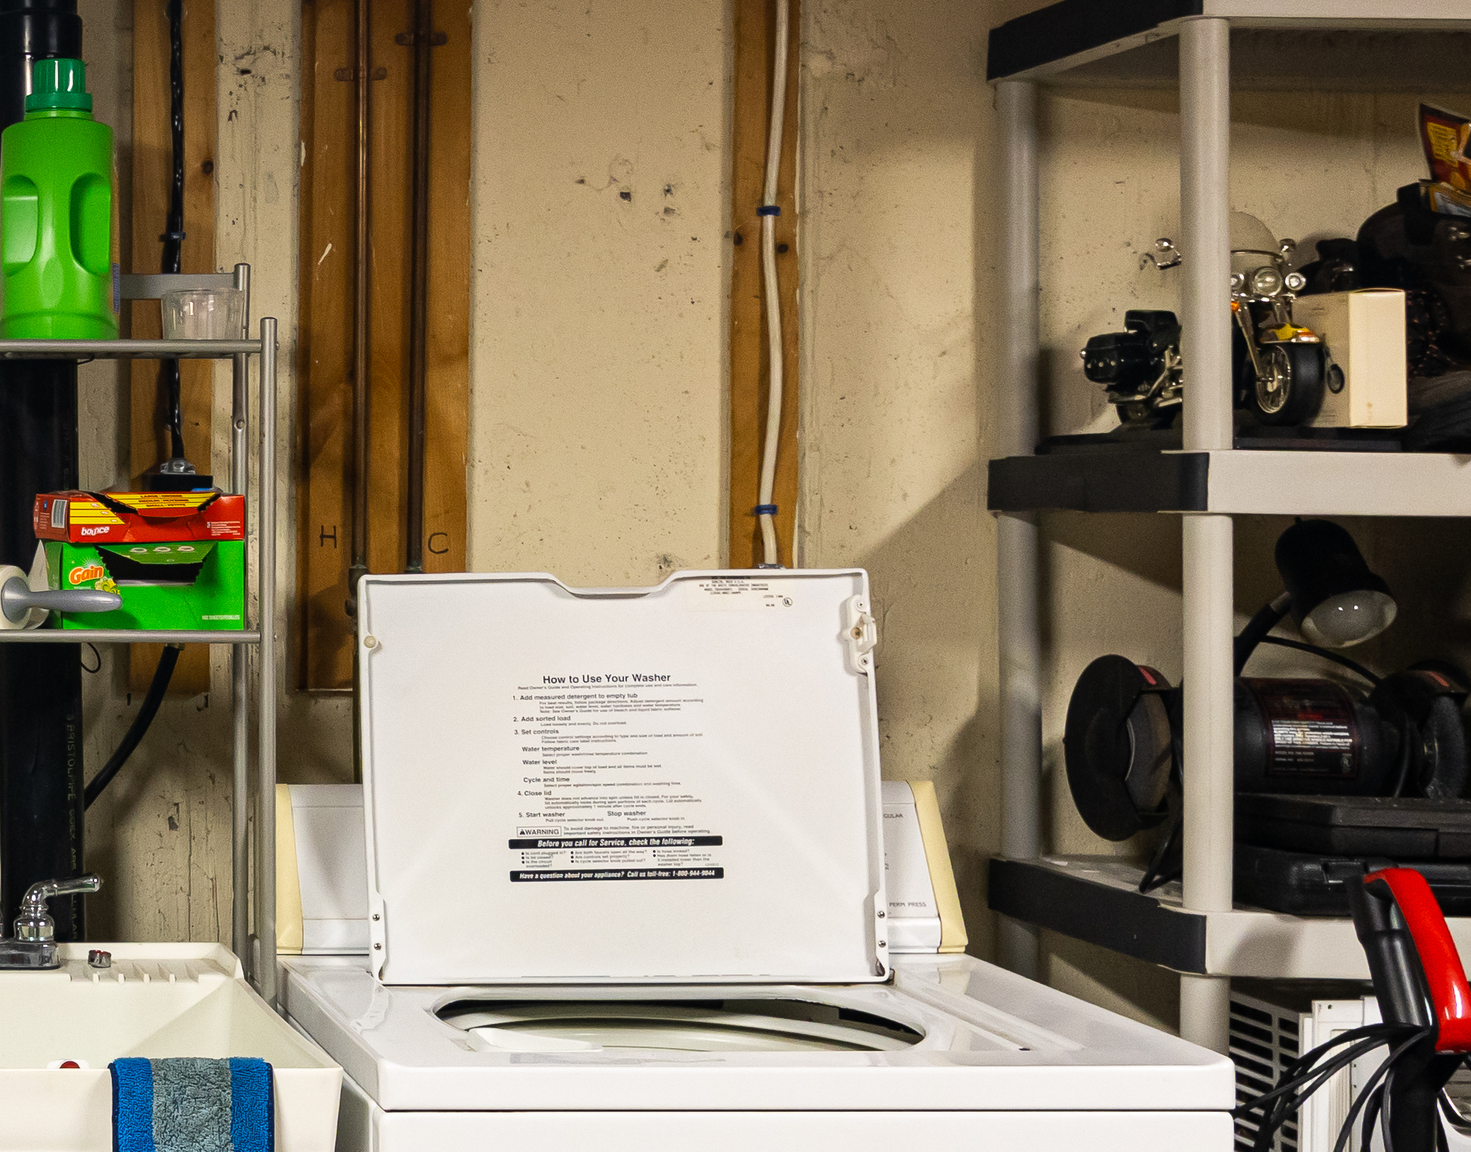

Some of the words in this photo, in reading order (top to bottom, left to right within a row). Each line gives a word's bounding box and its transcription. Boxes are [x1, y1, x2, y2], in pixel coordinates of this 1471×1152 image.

[81, 526, 110, 536] bounce
[320, 525, 337, 548] H
[428, 532, 449, 554] C
[69, 566, 104, 585] Gain
[583, 675, 602, 683] Use
[606, 674, 628, 683] Your
[632, 674, 670, 682] Washer
[662, 838, 695, 847] following:
